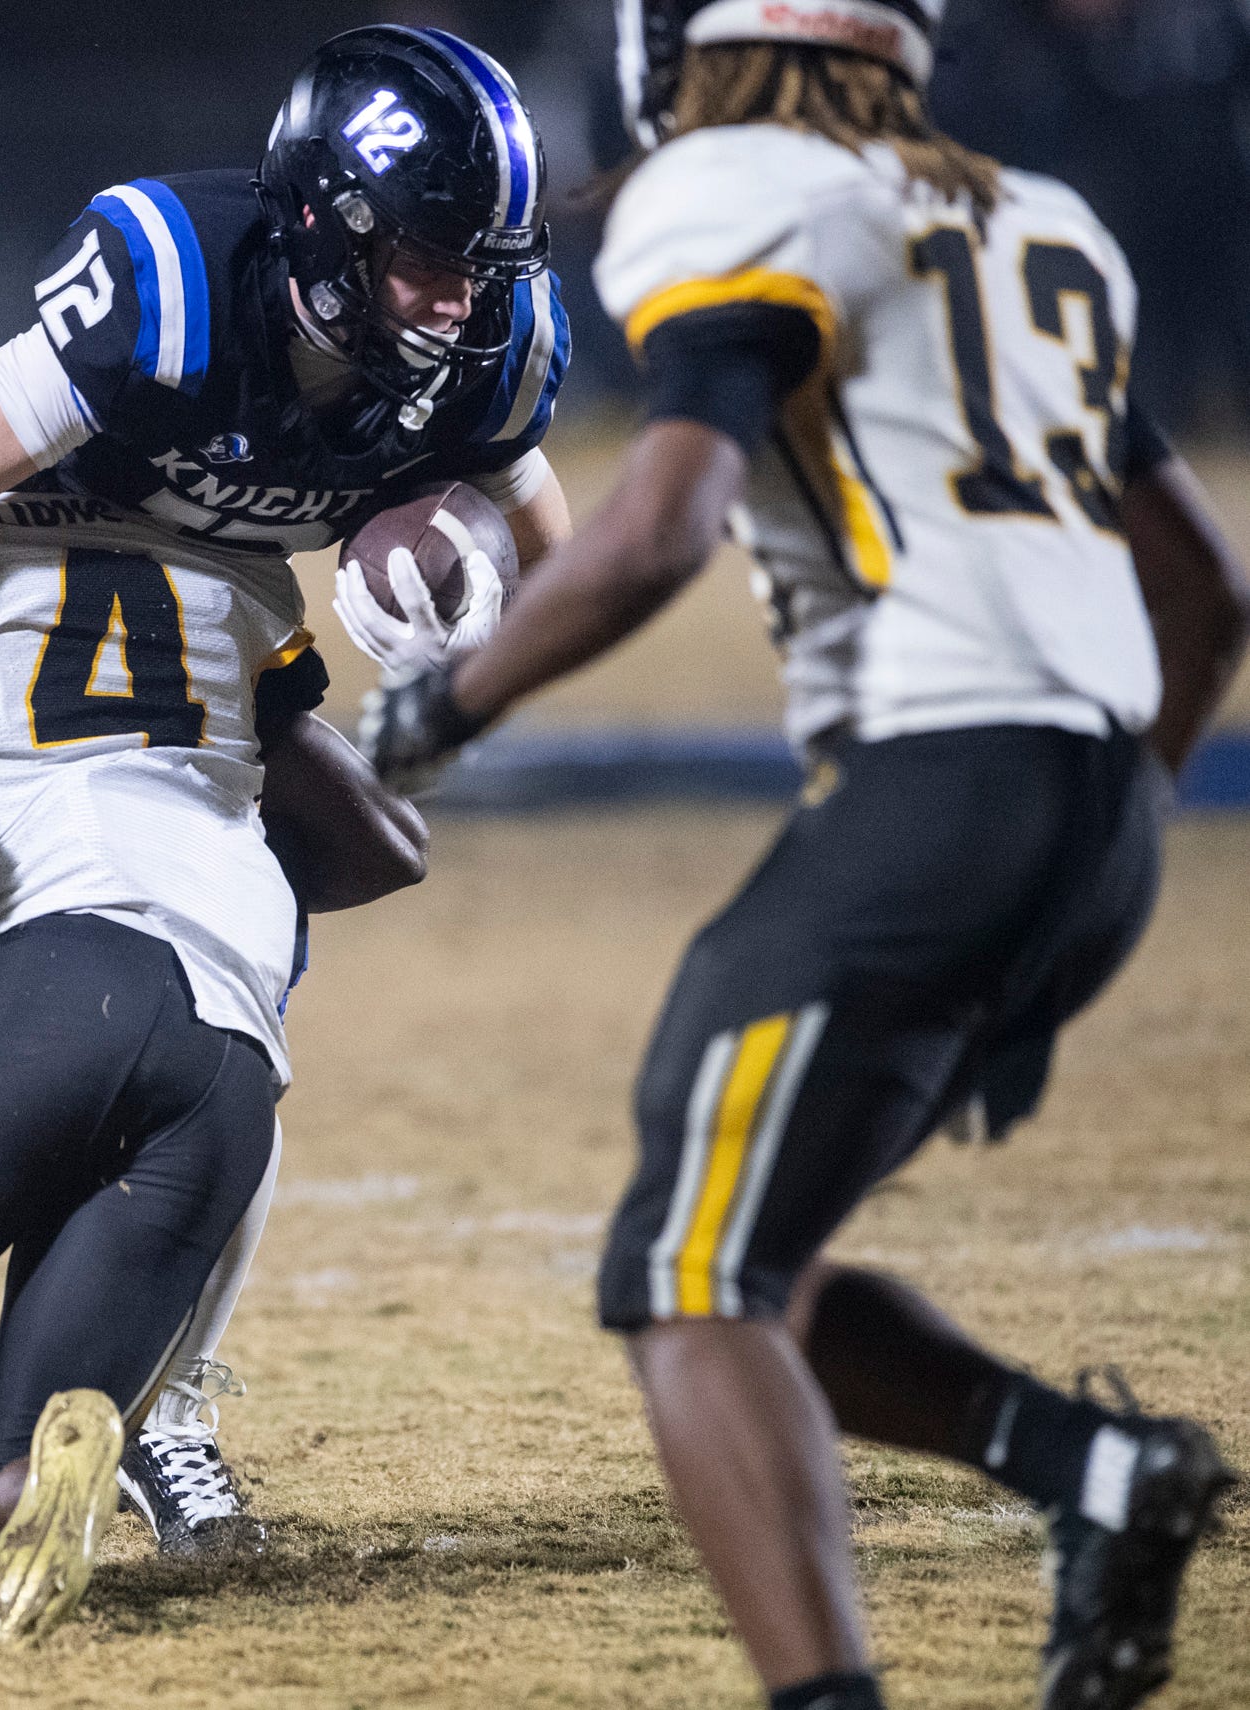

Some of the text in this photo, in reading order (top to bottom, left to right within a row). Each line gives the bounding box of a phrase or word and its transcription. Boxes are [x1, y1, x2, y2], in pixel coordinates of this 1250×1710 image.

[340, 87, 427, 177] 12
[34, 228, 114, 351] 12
[483, 231, 533, 250] Riddell
[908, 224, 1128, 545] 13
[25, 547, 210, 749] 4
